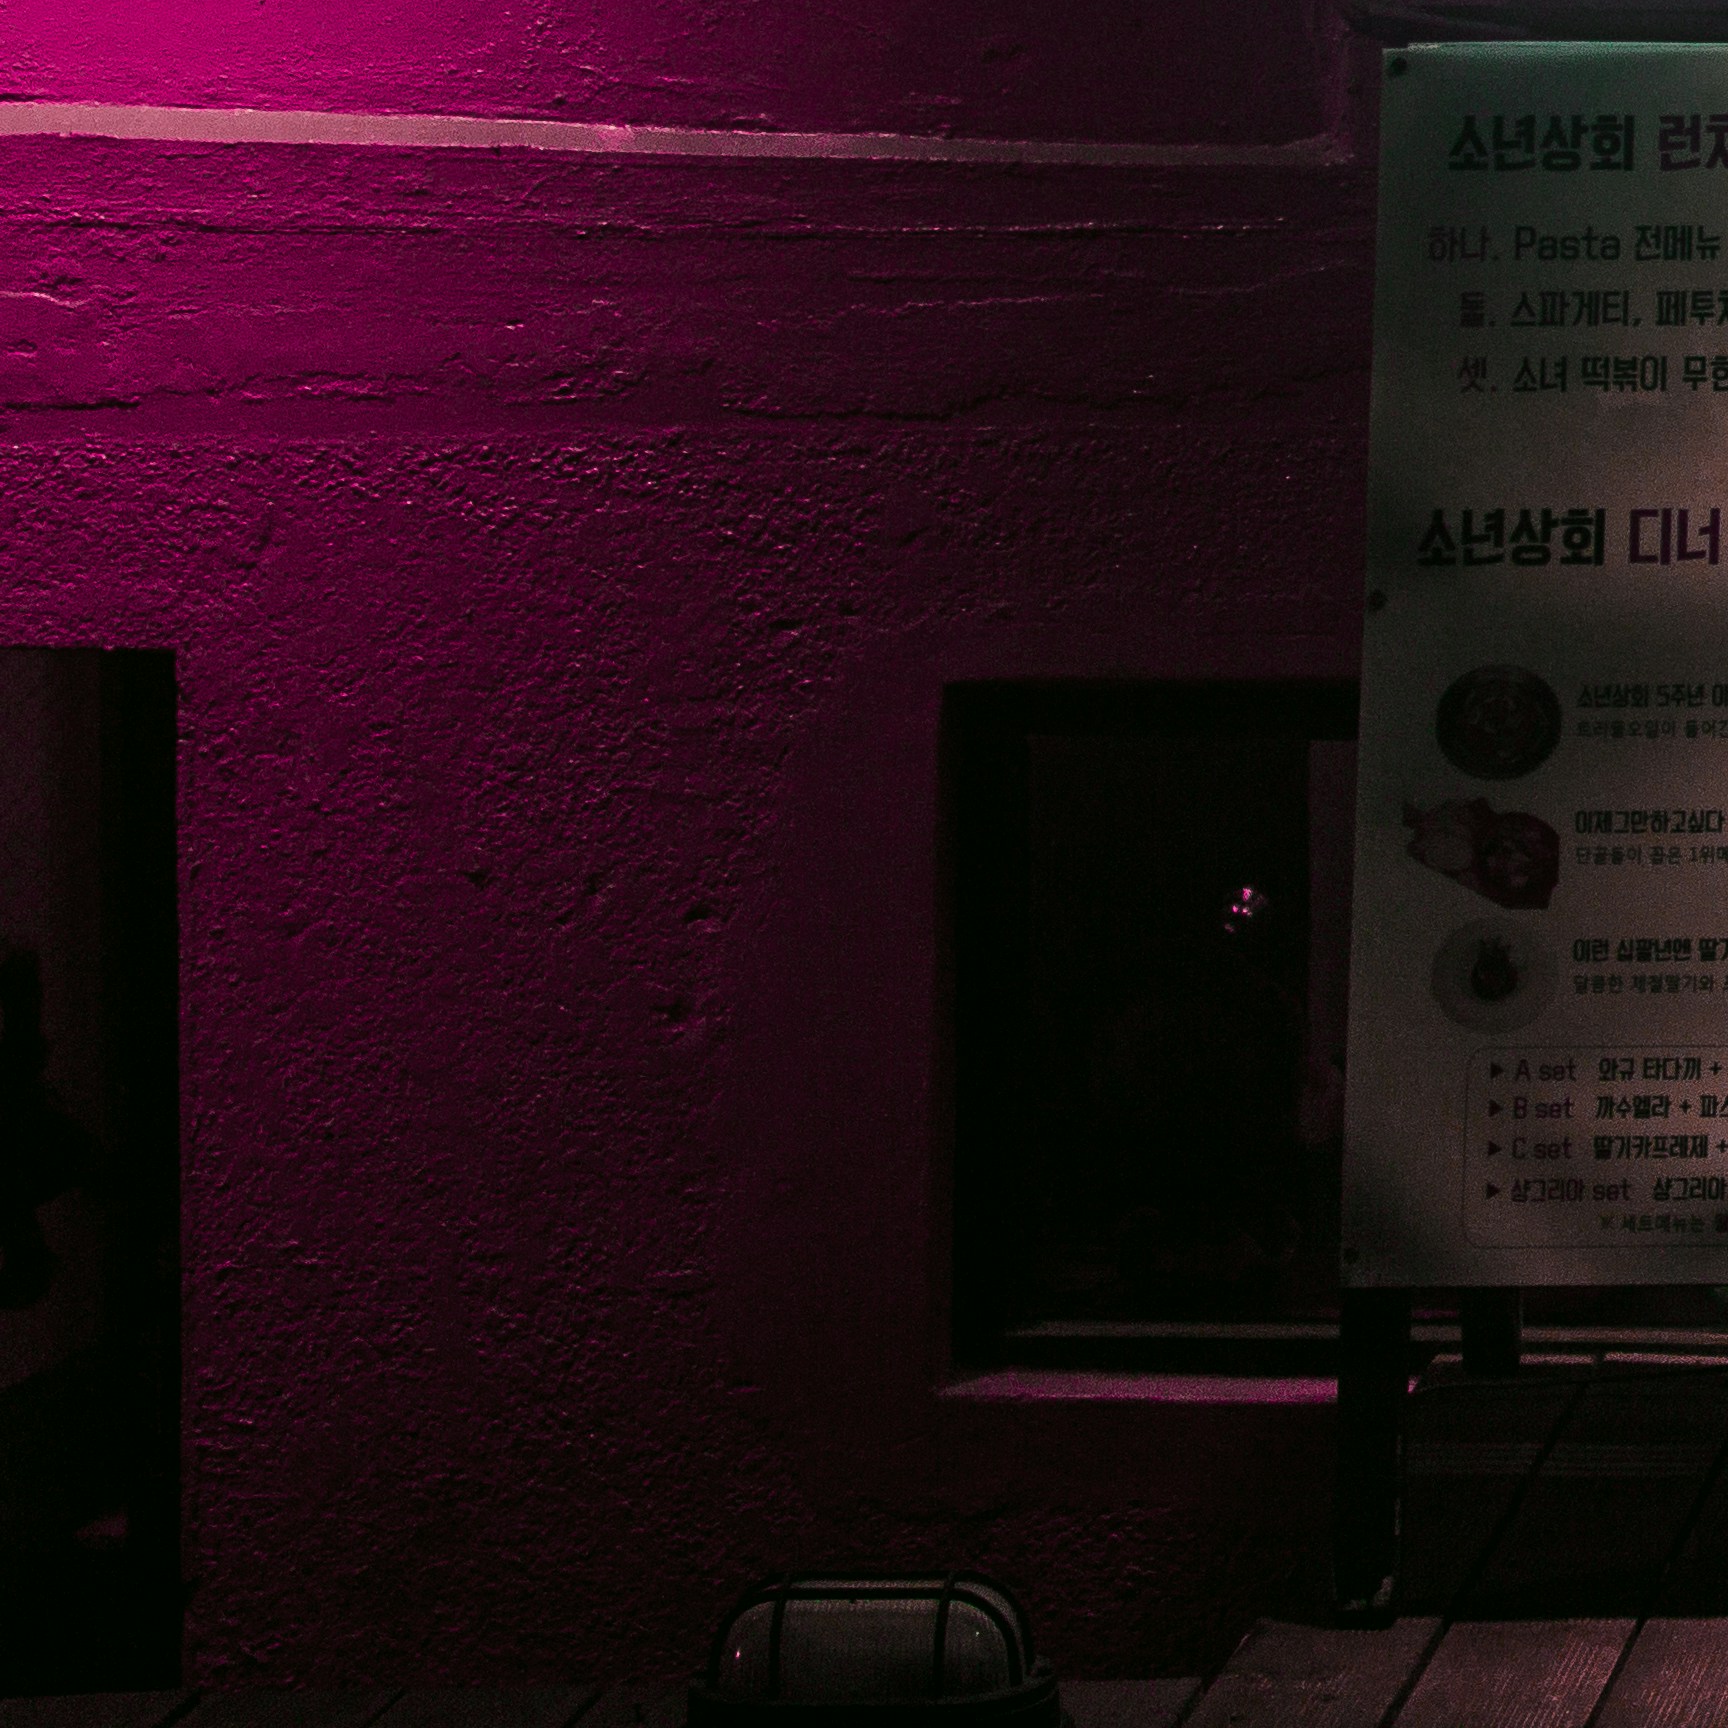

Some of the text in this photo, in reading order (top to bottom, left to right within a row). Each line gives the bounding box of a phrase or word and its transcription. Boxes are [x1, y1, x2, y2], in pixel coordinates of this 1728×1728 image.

[1448, 114, 1635, 172] 소년상회
[1427, 226, 1500, 262] 하나.
[1514, 227, 1620, 261] Pasta
[1634, 224, 1722, 262] 전메뉴
[1510, 290, 1643, 328] 스파게티,
[1458, 358, 1496, 394] 셋.
[1513, 358, 1567, 394] 소녀
[1582, 356, 1667, 394] 떡볶이
[1416, 508, 1605, 567] 소년상회
[1628, 508, 1720, 567] 디너
[1577, 684, 1648, 708] 소년상회
[1657, 684, 1705, 708] 5주년
[1575, 810, 1724, 834] 이제그만하고싶다
[1577, 847, 1642, 864] 단골들이
[1573, 939, 1609, 962] 이런
[1516, 1059, 1531, 1081] A
[1539, 1062, 1576, 1082] set
[1599, 1058, 1635, 1082] 와규
[1643, 1057, 1700, 1081] 타다끼
[1513, 1097, 1529, 1119] B
[1535, 1099, 1572, 1119] set
[1595, 1097, 1669, 1119] 까수엘라
[1512, 1137, 1525, 1161] C
[1534, 1139, 1571, 1161] set
[1594, 1136, 1707, 1160] 딸기카프레제
[1592, 1181, 1630, 1201] set
